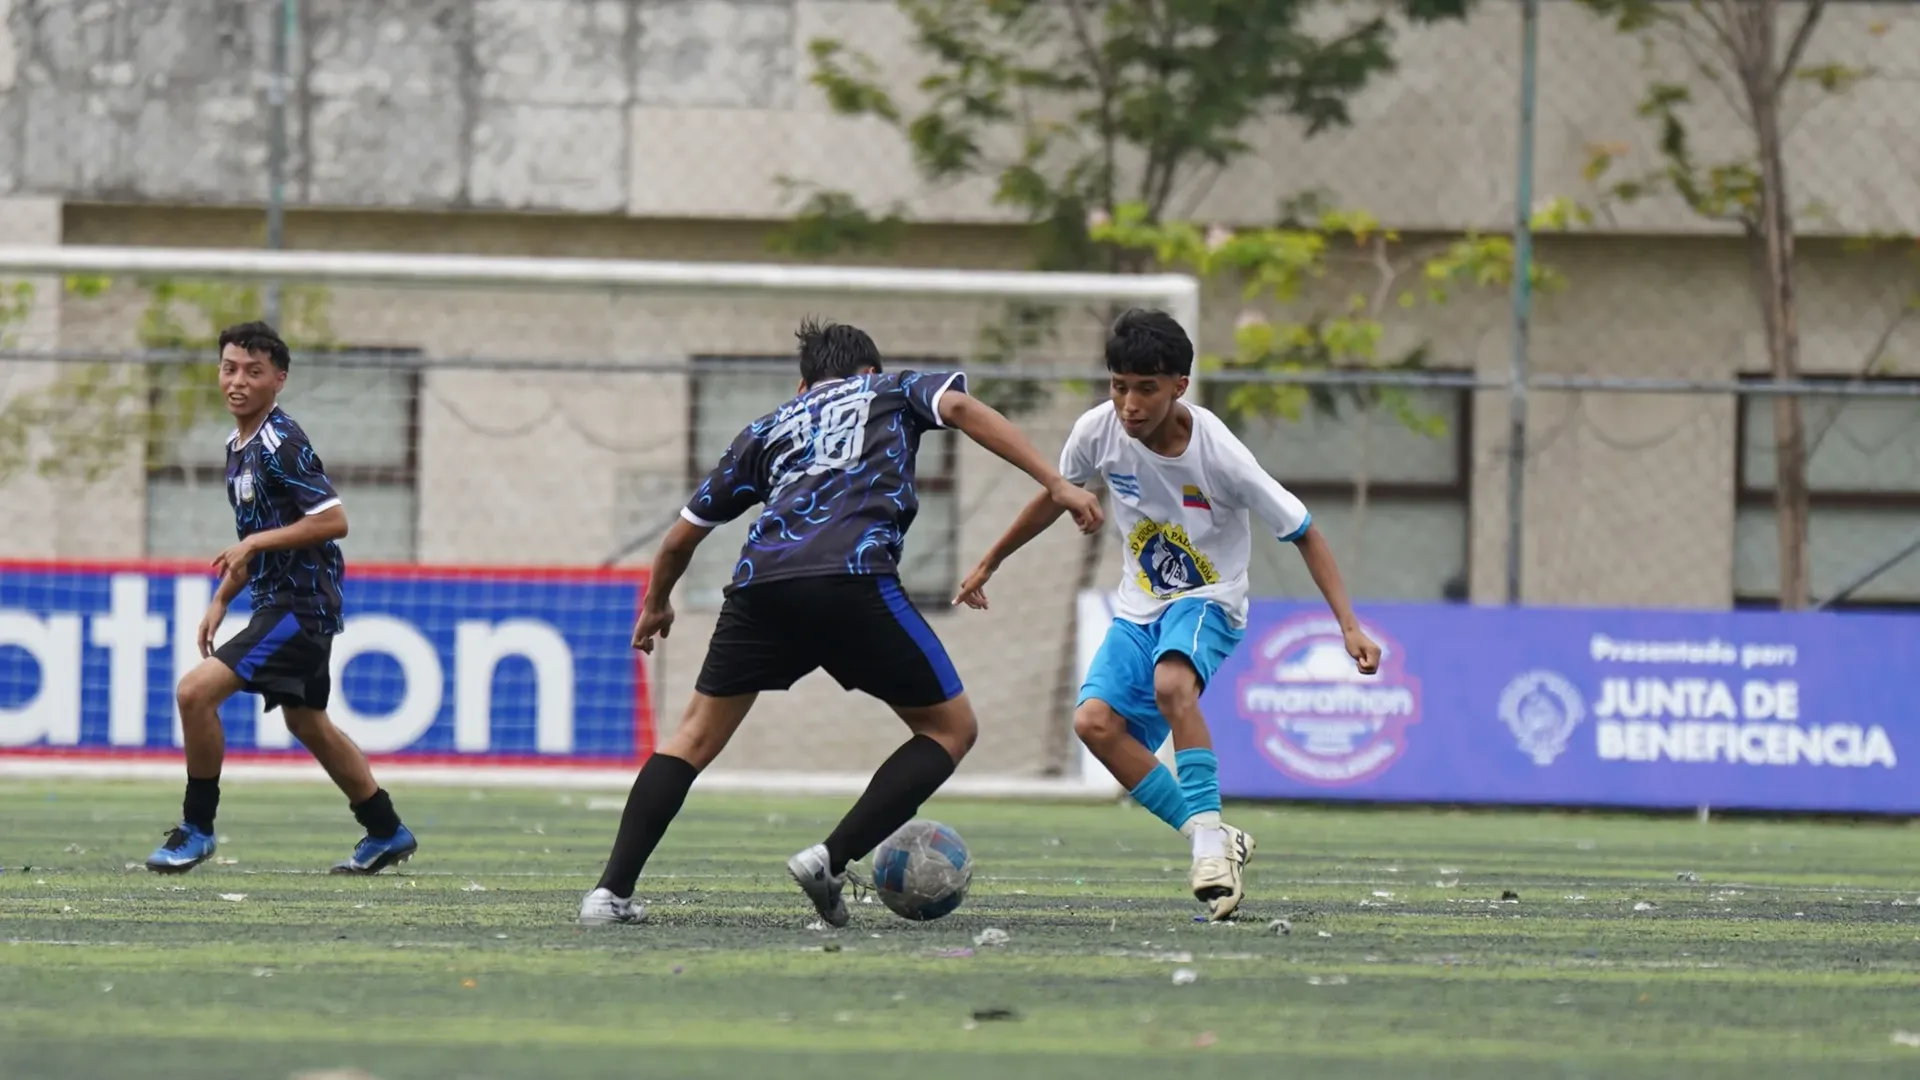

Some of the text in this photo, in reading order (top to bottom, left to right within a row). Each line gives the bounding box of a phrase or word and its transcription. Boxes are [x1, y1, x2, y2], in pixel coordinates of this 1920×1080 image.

[1590, 633, 1737, 665] Presentado
[1593, 676, 1799, 720] JUNTA DE
[1596, 718, 1898, 769] BENEFICENCIA
